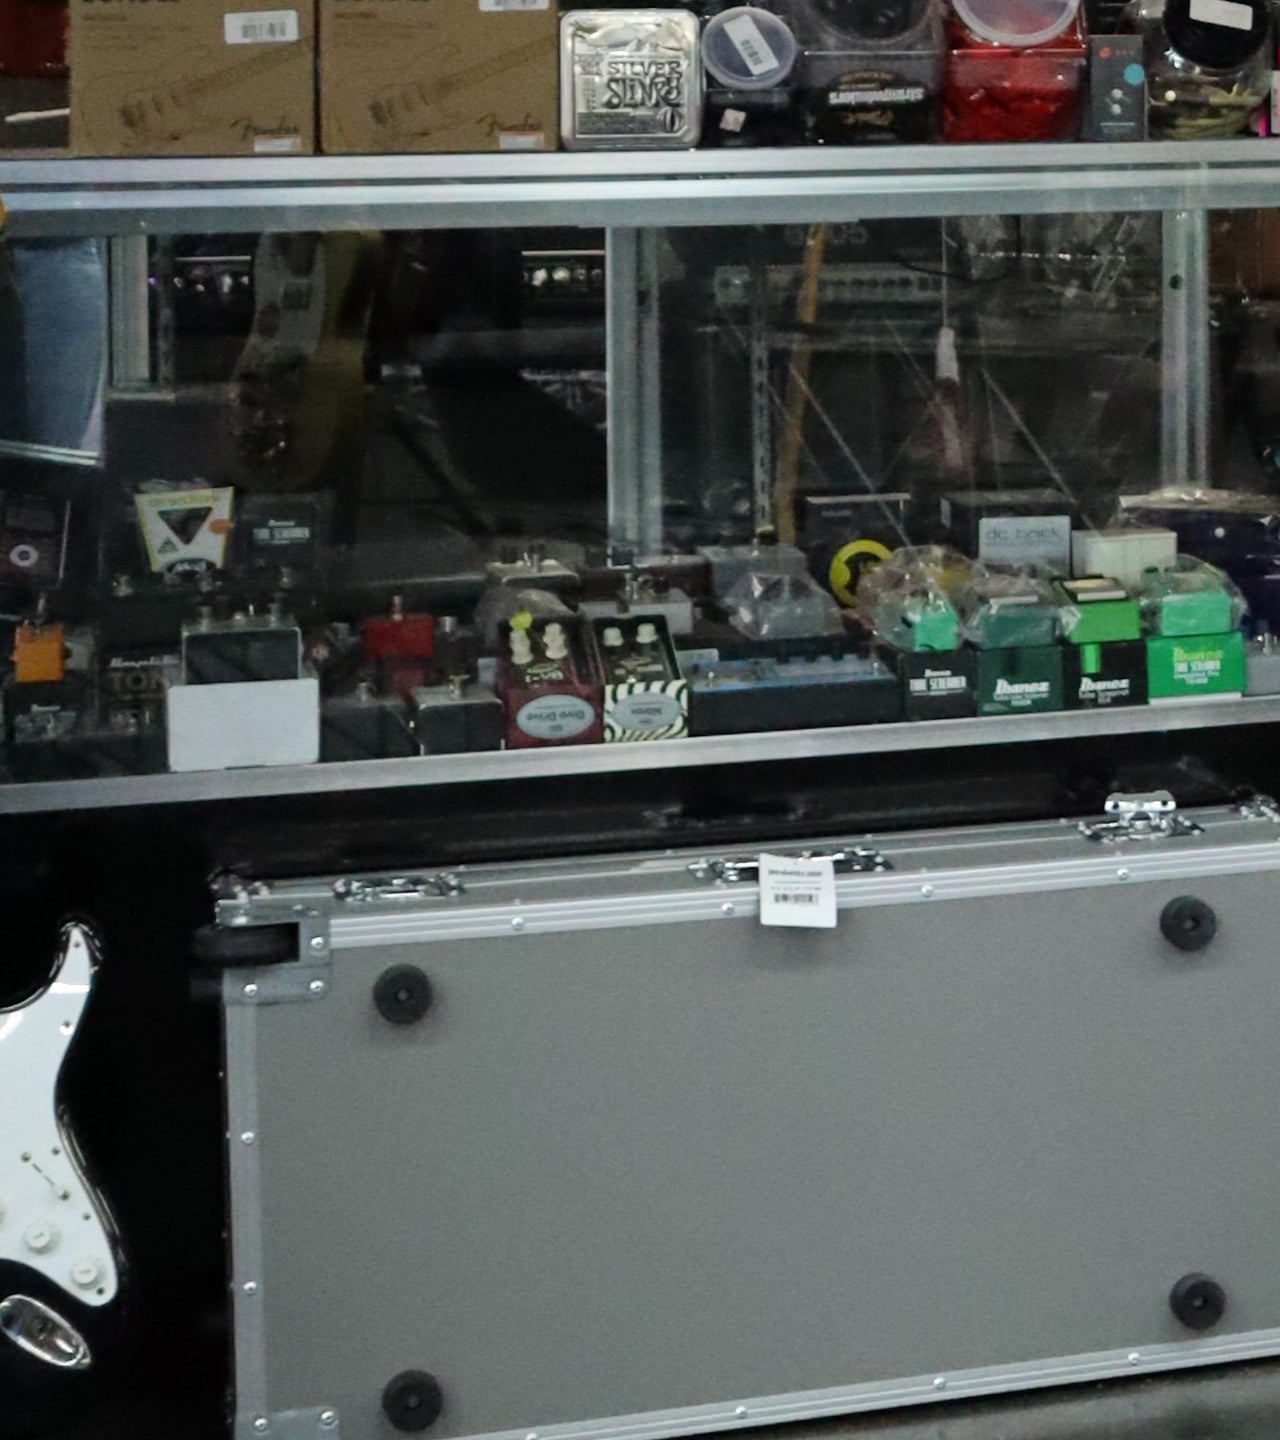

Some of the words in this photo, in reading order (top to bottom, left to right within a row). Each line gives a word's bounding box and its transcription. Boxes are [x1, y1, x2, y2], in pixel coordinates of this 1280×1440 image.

[607, 60, 683, 78] SILVER
[601, 77, 684, 109] SLINKY
[995, 678, 1050, 694] Ibanez
[1080, 677, 1130, 693] Ibanez
